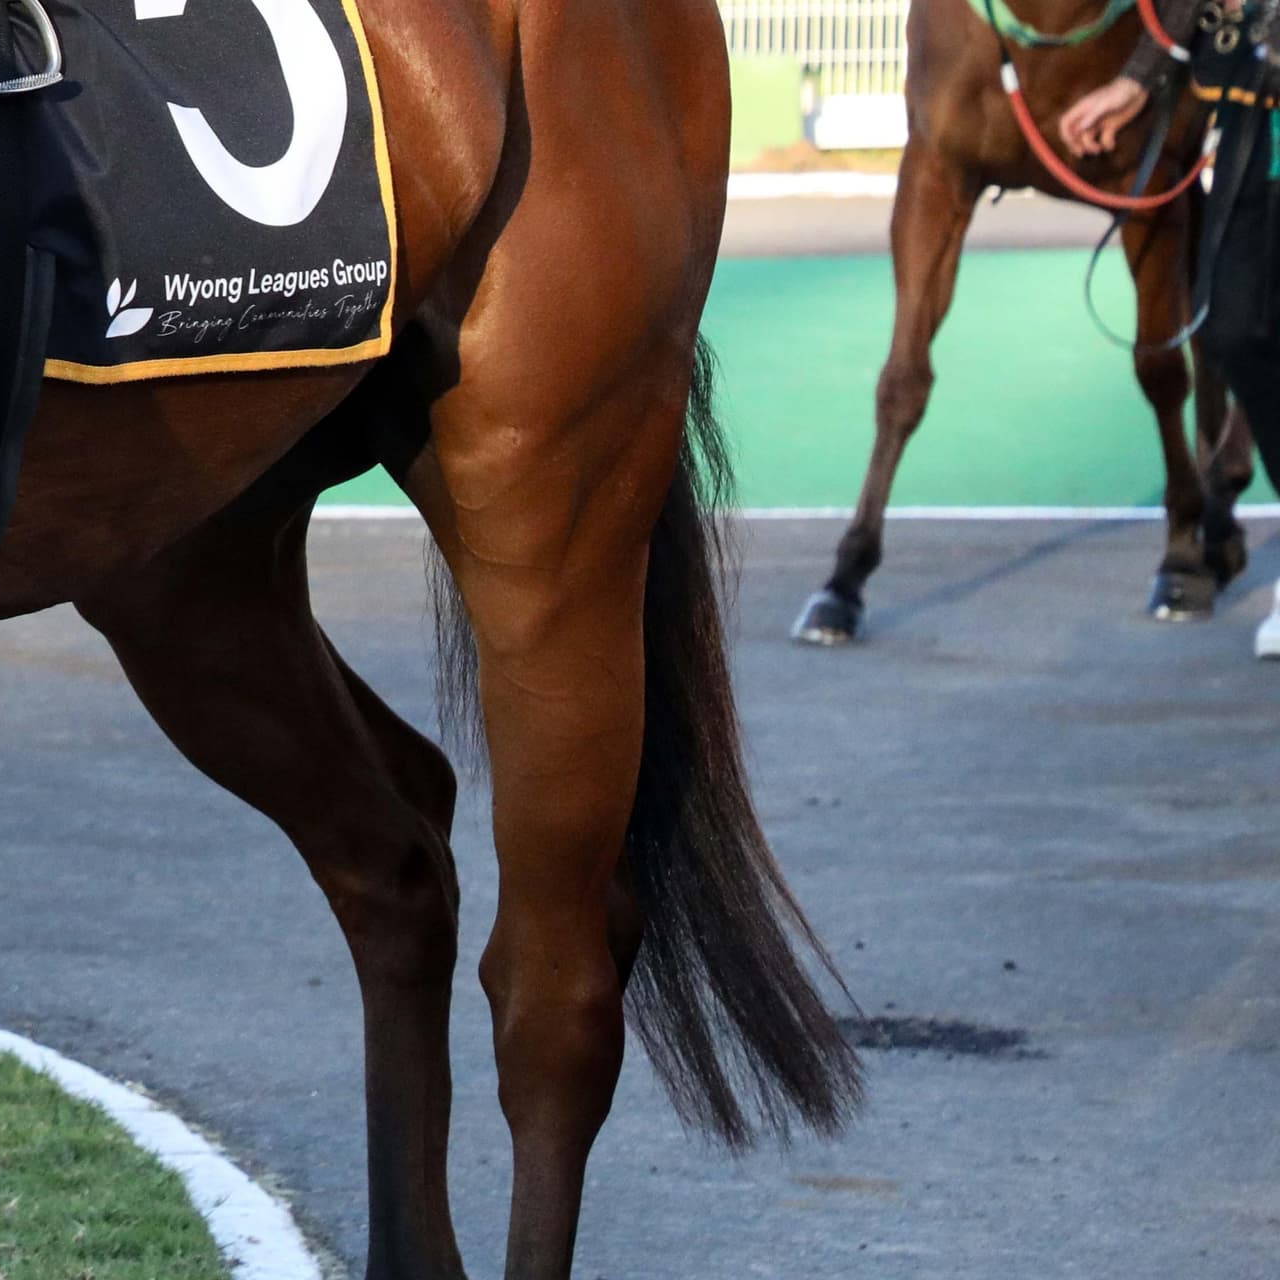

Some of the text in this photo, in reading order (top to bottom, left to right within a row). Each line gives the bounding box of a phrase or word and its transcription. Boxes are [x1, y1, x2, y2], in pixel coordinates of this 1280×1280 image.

[164, 258, 388, 307] Wyong Leagues Group
[156, 310, 233, 344] Bringing
